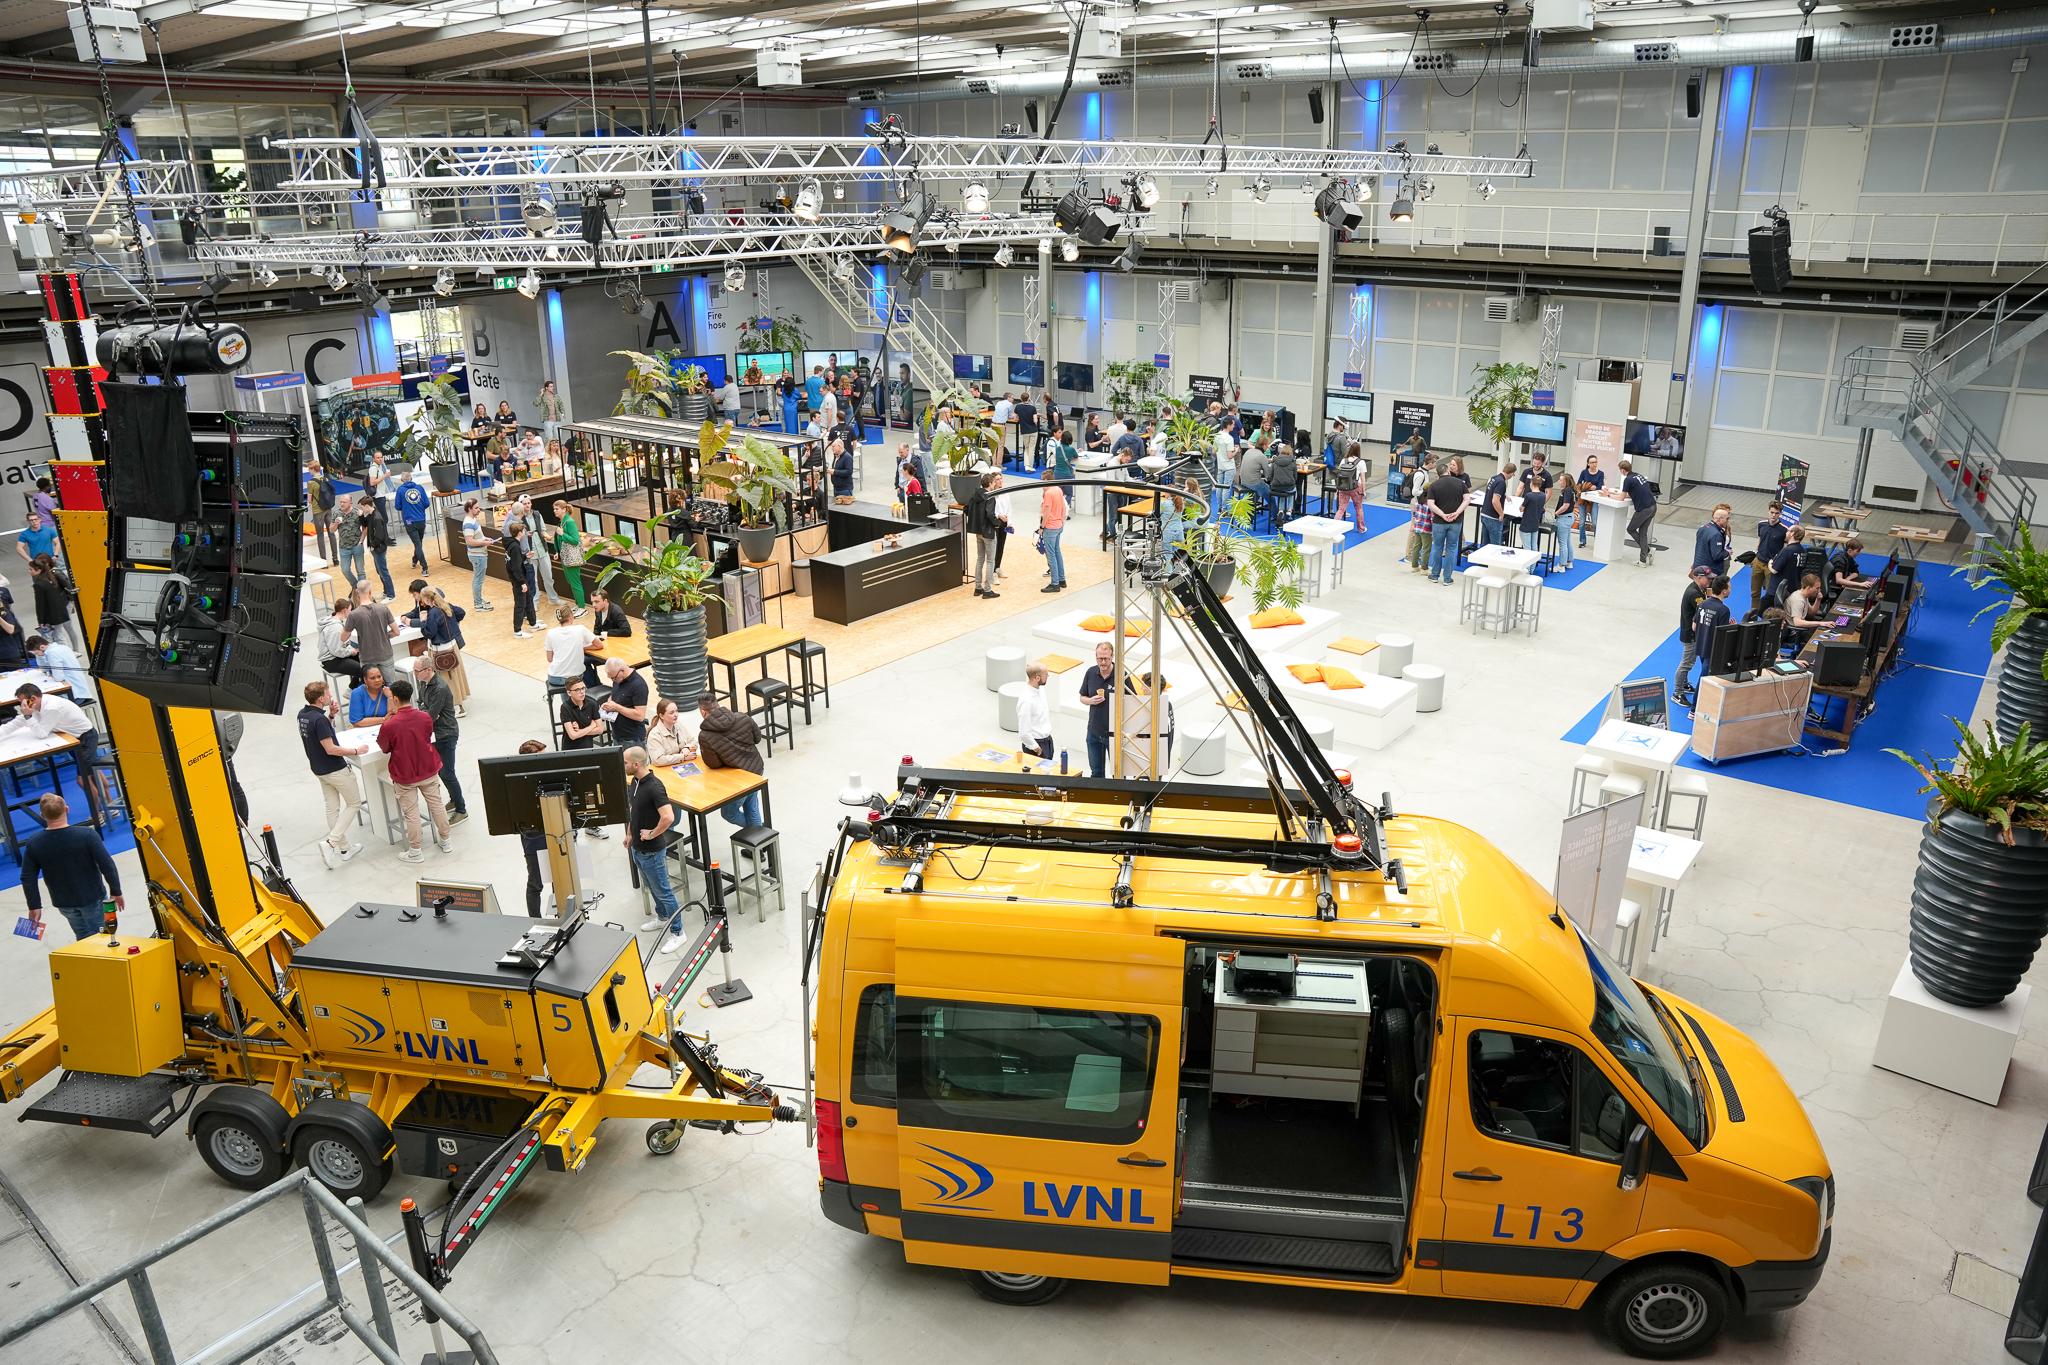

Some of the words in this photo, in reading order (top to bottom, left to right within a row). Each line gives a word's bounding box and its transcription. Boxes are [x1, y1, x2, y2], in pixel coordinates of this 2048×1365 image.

[645, 300, 682, 348] A
[707, 311, 723, 321] Fire
[708, 321, 727, 330] hose
[471, 314, 490, 358] B
[304, 338, 347, 388] C
[472, 367, 500, 390] Gate
[1585, 429, 1612, 437] DRAGENDE
[551, 1003, 573, 1033] 5
[402, 1031, 489, 1066] LVNL
[1023, 1181, 1156, 1225] LVNL
[1491, 1203, 1585, 1243] L13
